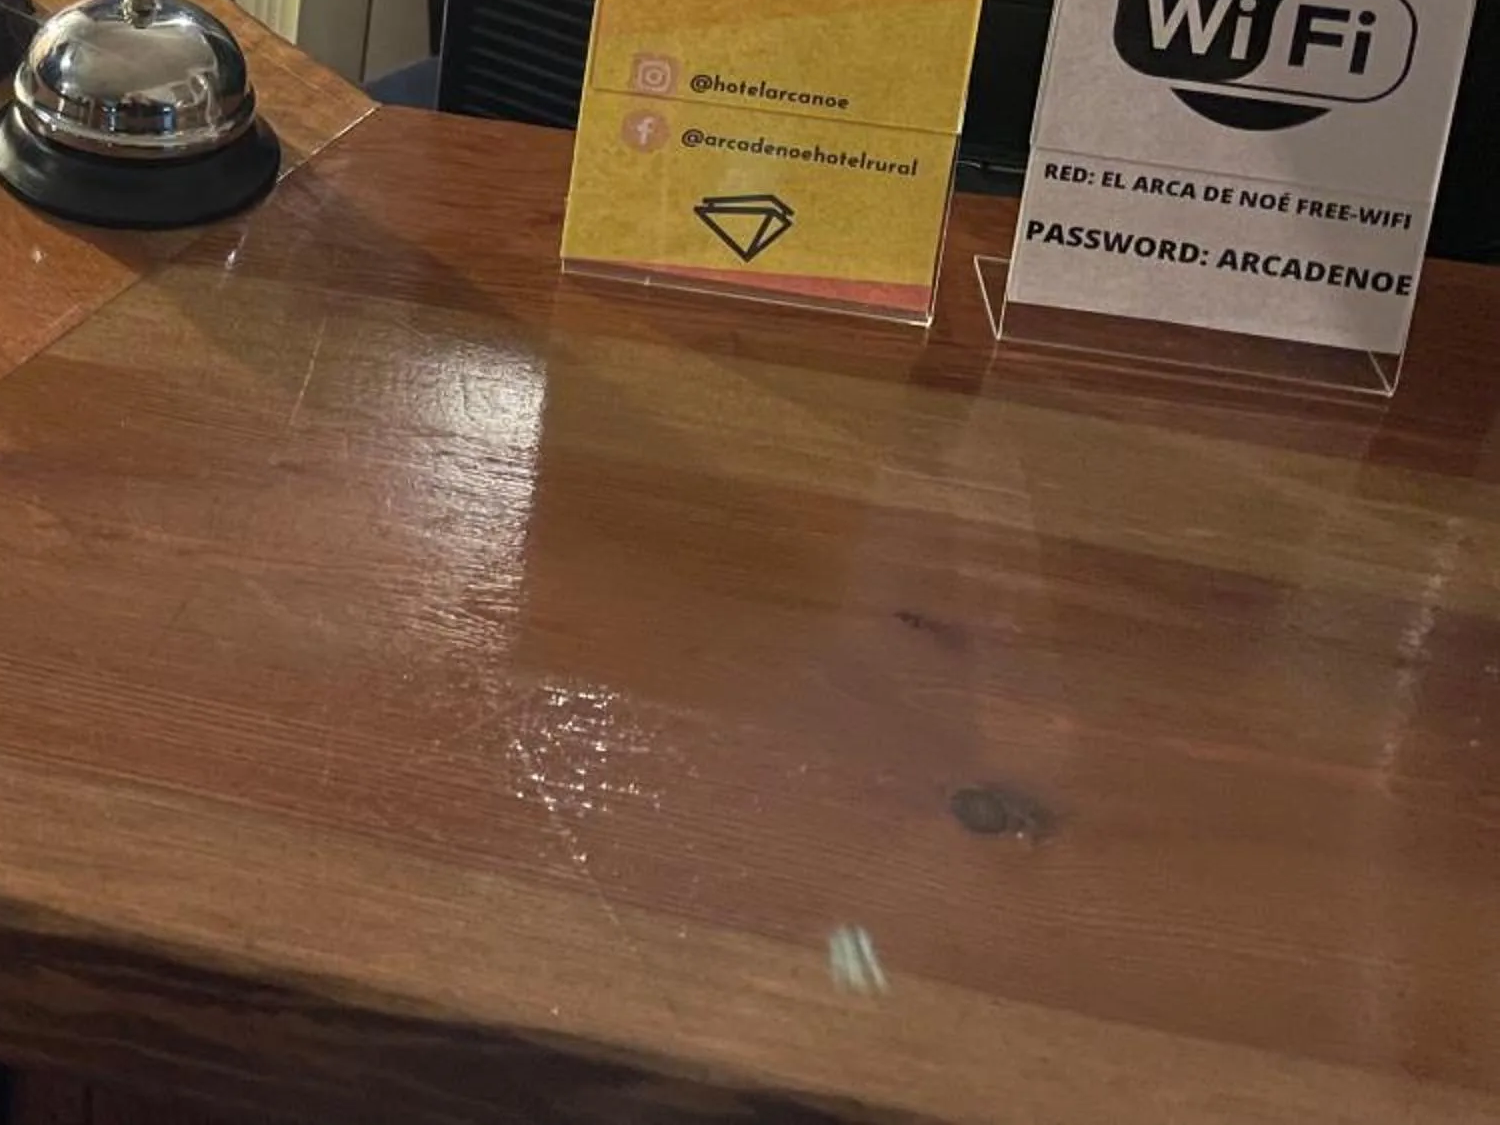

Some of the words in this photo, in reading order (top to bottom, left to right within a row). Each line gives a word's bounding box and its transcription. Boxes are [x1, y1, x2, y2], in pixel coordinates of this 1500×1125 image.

[690, 74, 850, 109] @hotelarcanoe
[681, 128, 918, 176] @arcadenoehotelrural
[1044, 163, 1095, 185] RED:
[1101, 171, 1125, 189] EL
[1132, 176, 1197, 199] ARCA
[1203, 186, 1234, 204] DE
[1239, 190, 1292, 212] NOÉ
[1296, 198, 1412, 230] FREE-WIFI
[1026, 220, 1209, 266] PASSWORD:
[1216, 249, 1413, 296] ARCADENOE
